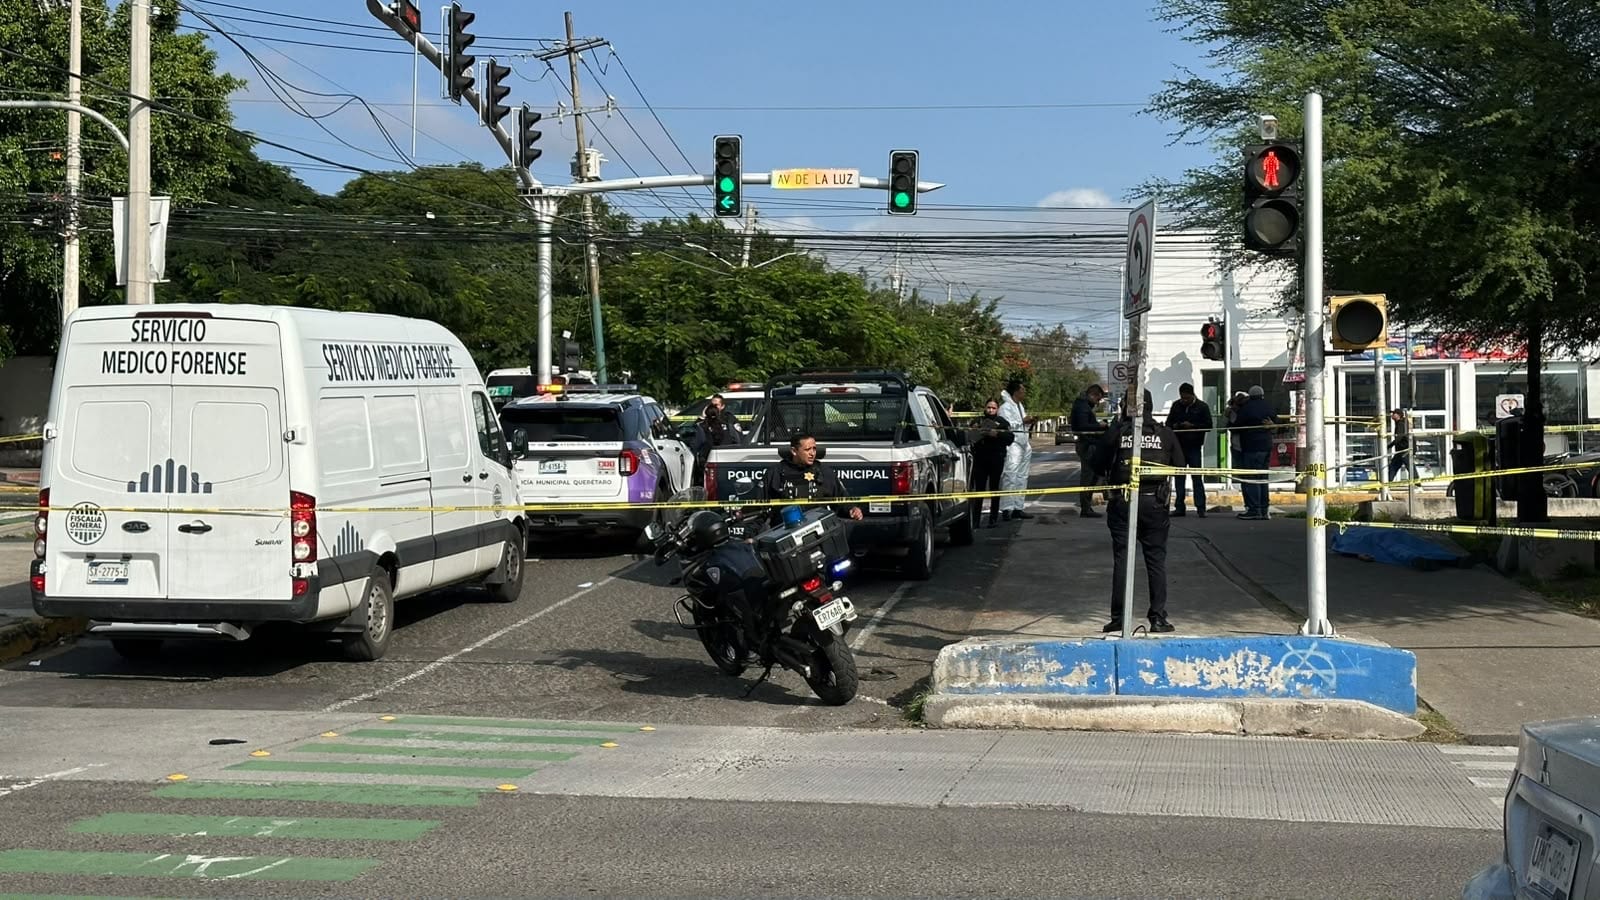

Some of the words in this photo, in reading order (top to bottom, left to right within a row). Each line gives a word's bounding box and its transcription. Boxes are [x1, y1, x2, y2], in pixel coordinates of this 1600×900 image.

[777, 174, 790, 183] AV
[795, 174, 809, 184] DE
[815, 174, 829, 184] LA
[833, 173, 853, 184] LUZ
[131, 319, 206, 342] SERVICIO
[101, 350, 167, 374] MEDICO
[171, 351, 247, 375] FORENSE
[322, 343, 375, 381] SERVICIO
[373, 345, 415, 380] MEDICO
[412, 345, 456, 379] FORENSE
[1121, 434, 1161, 443] POICÍA
[70, 521, 102, 529] GENERAL
